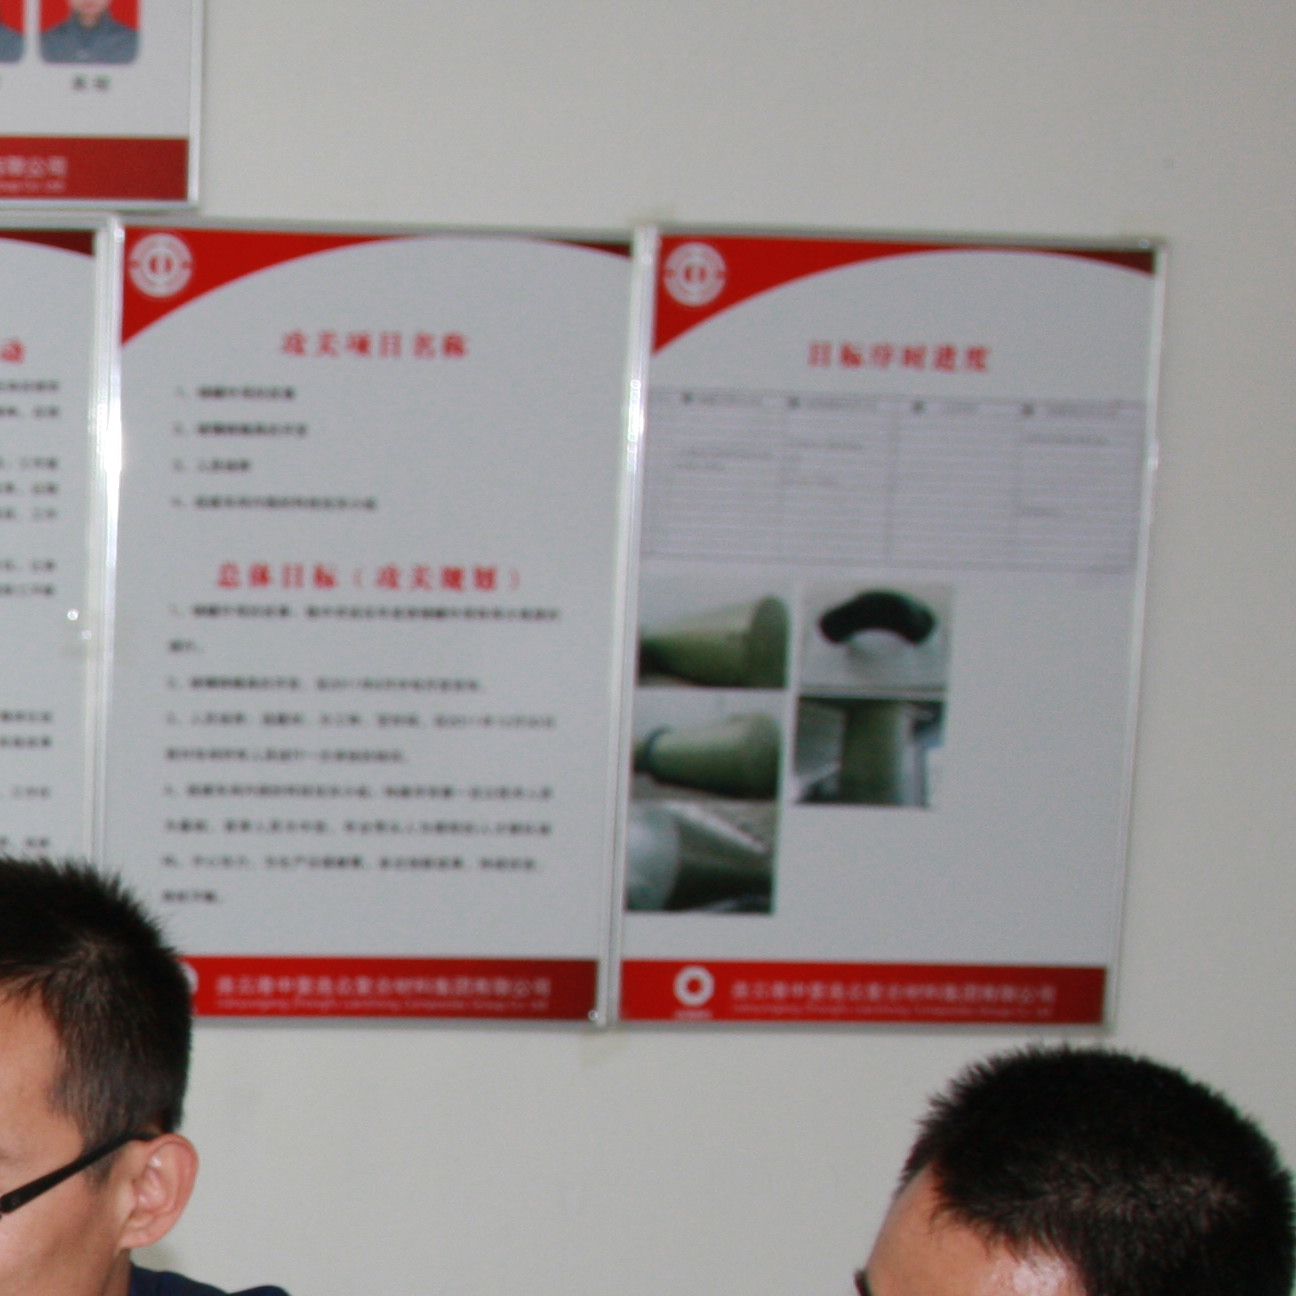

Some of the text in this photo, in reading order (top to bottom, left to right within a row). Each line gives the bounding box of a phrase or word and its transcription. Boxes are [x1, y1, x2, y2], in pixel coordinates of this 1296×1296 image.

[281, 331, 470, 359] 攻关项目名称
[808, 342, 991, 372] 目标序时进度
